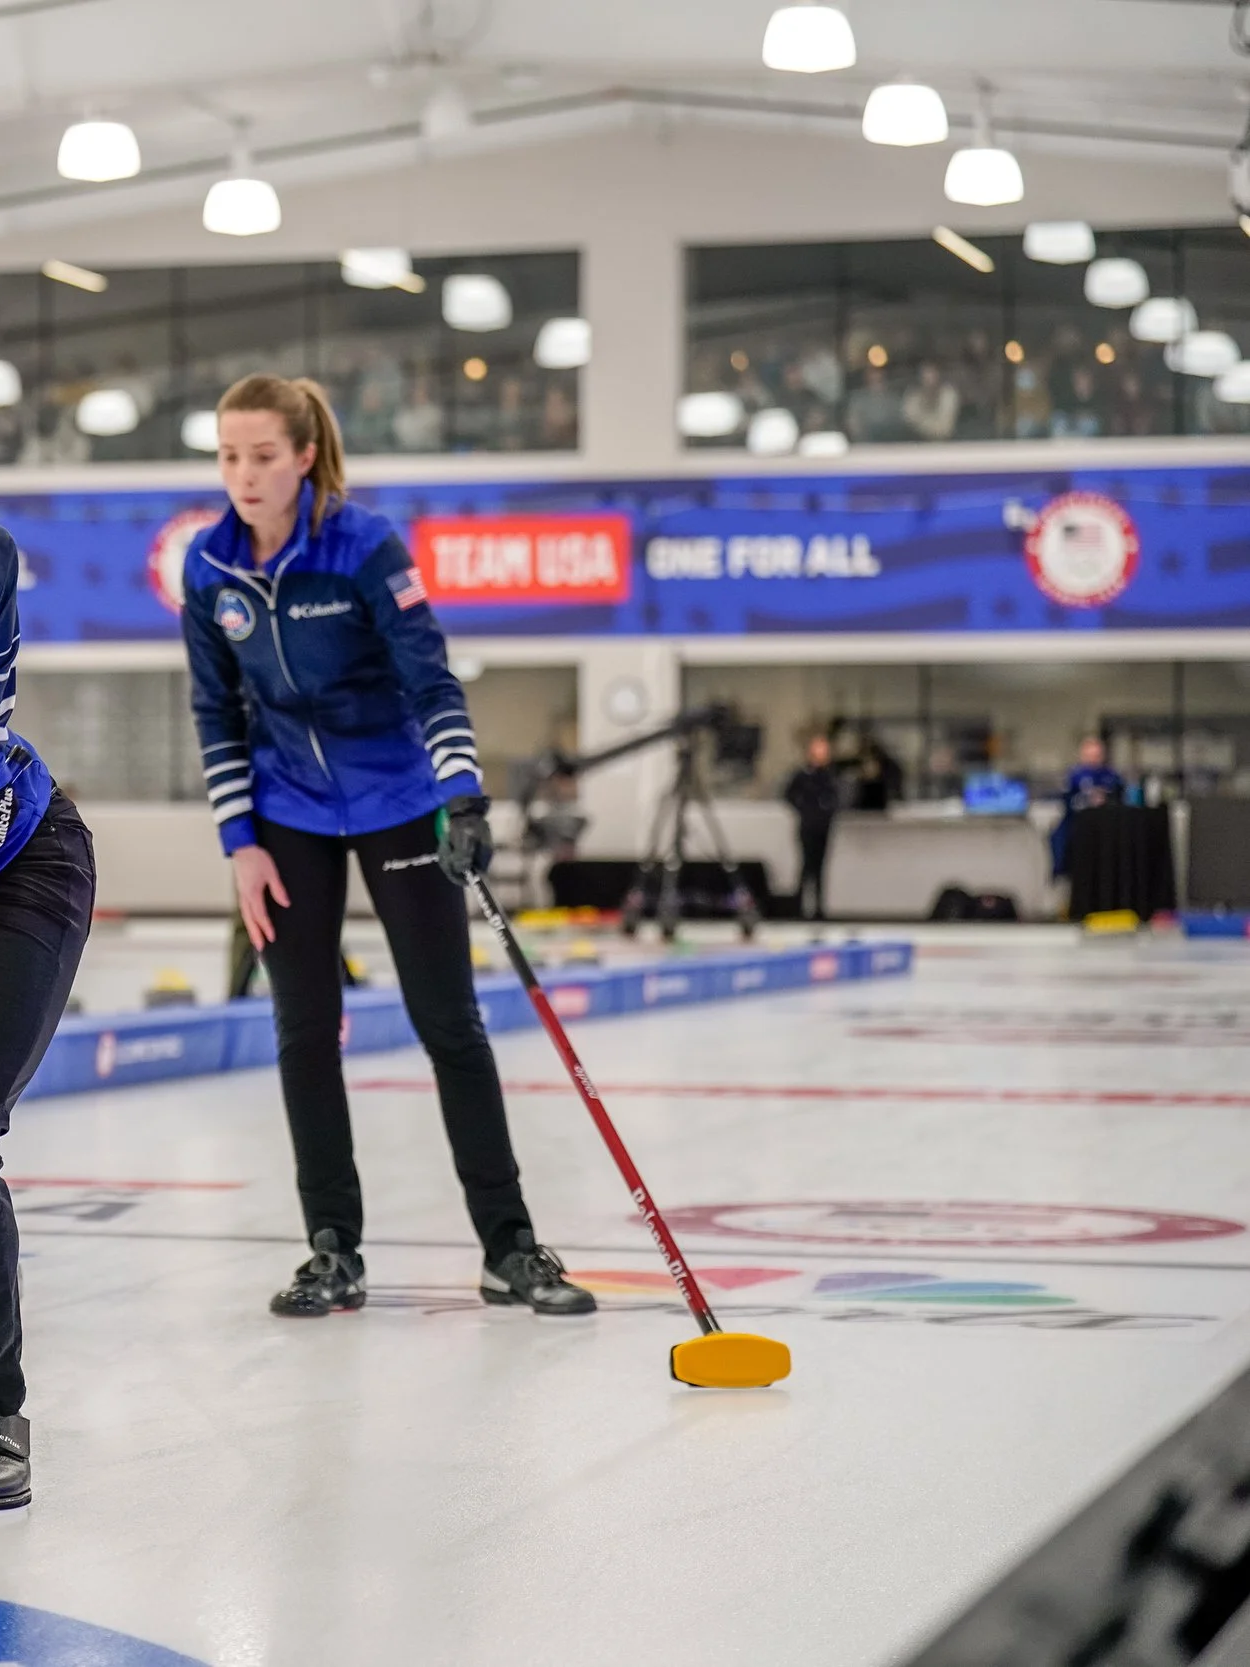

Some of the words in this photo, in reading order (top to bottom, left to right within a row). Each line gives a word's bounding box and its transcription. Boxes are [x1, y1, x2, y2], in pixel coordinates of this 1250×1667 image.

[431, 532, 533, 589] TEAM
[535, 531, 619, 587] USA
[645, 534, 724, 580] ONE
[725, 533, 803, 580] FOR
